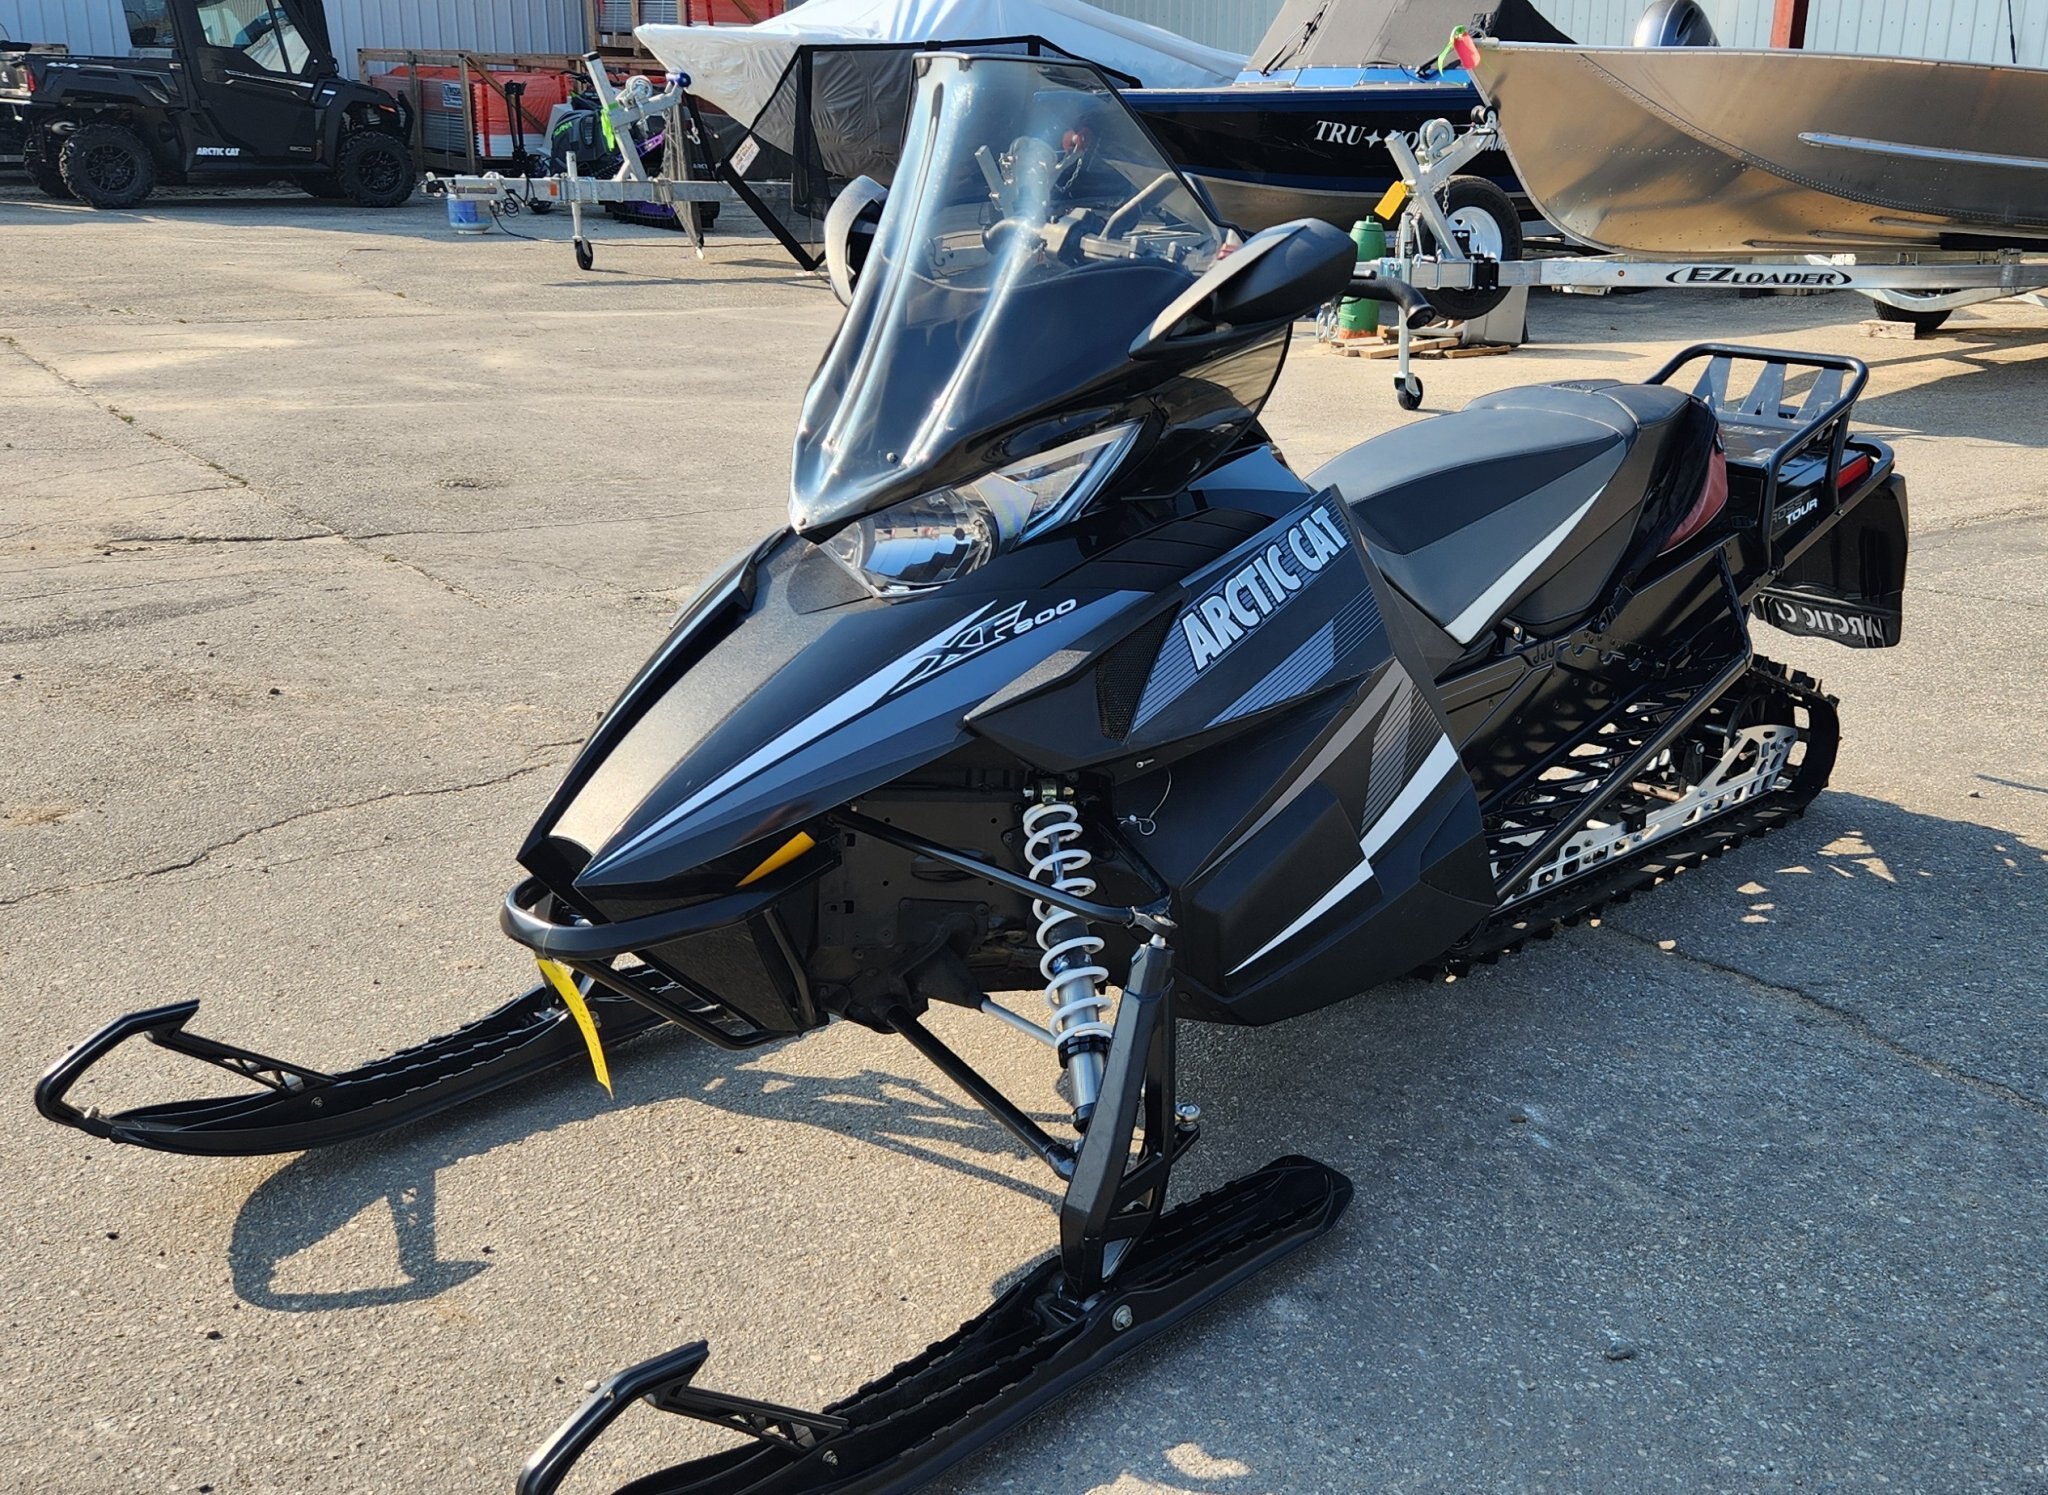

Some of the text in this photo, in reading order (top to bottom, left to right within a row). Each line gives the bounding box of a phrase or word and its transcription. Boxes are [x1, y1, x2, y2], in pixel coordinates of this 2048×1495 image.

[196, 147, 240, 156] ARCTIC CAT
[1785, 498, 1818, 525] TOUR
[1182, 506, 1348, 671] ARCTIC CAT
